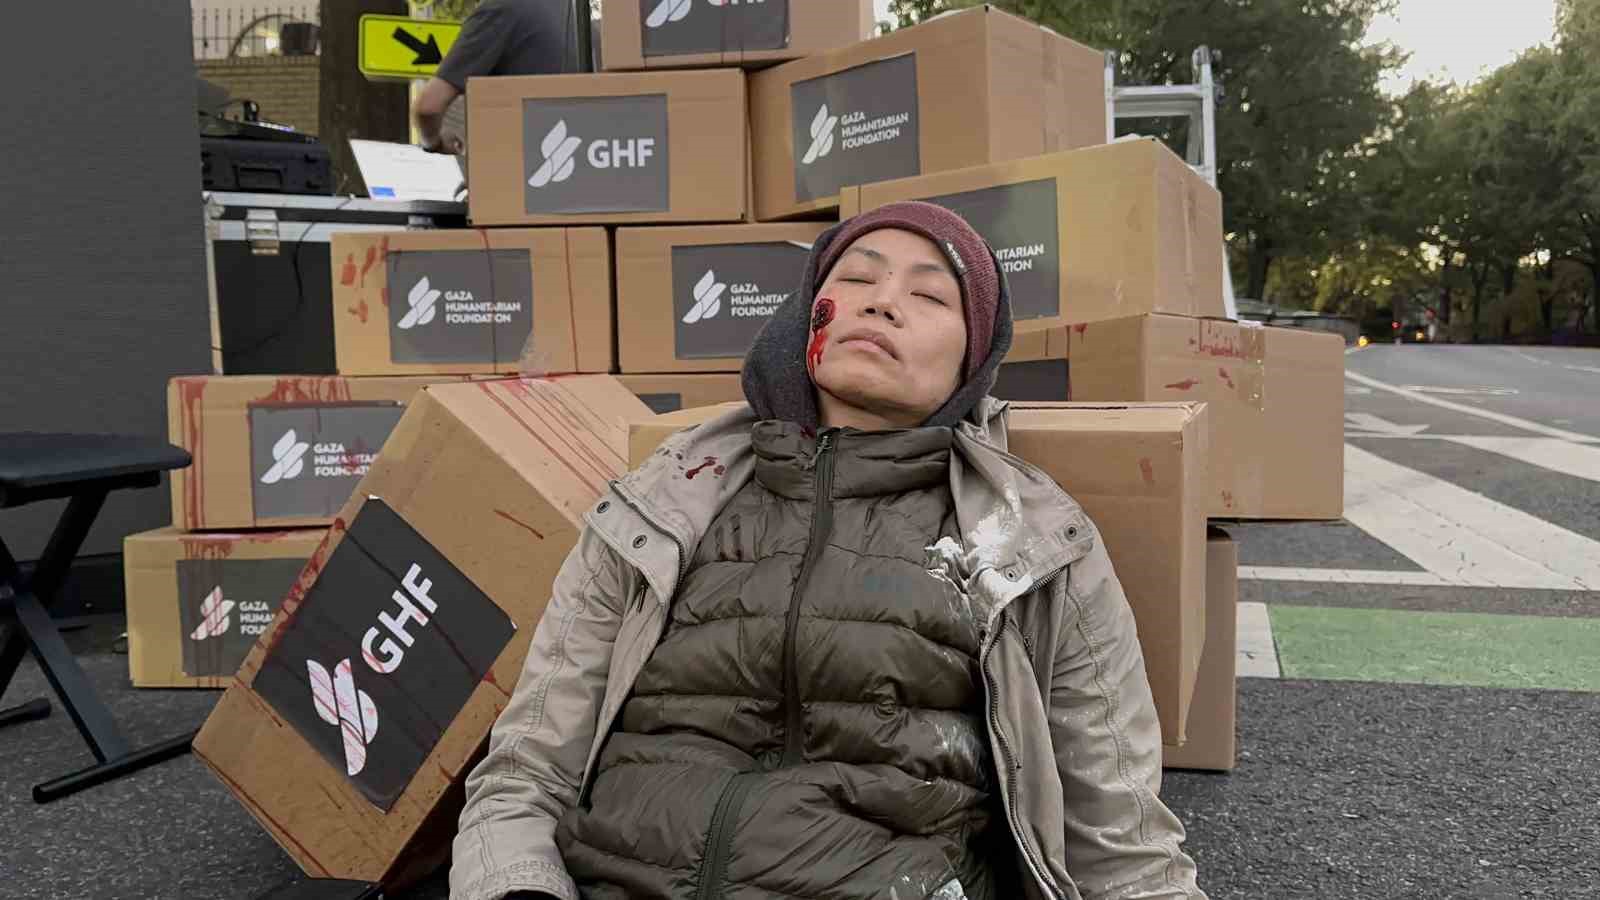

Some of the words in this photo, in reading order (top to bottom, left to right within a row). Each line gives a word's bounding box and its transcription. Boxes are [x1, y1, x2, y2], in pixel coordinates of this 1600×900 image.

[841, 112, 865, 125] GAZA
[842, 112, 908, 137] HUMANITARIAN
[842, 127, 900, 150] FOUNDATION
[587, 138, 655, 168] GHF
[730, 284, 759, 294] GAZA
[445, 291, 473, 300] GAZA
[446, 314, 511, 323] FOUNDATON
[313, 443, 345, 454] GAZA
[239, 601, 268, 612] GAZA
[361, 562, 438, 674] GHF
